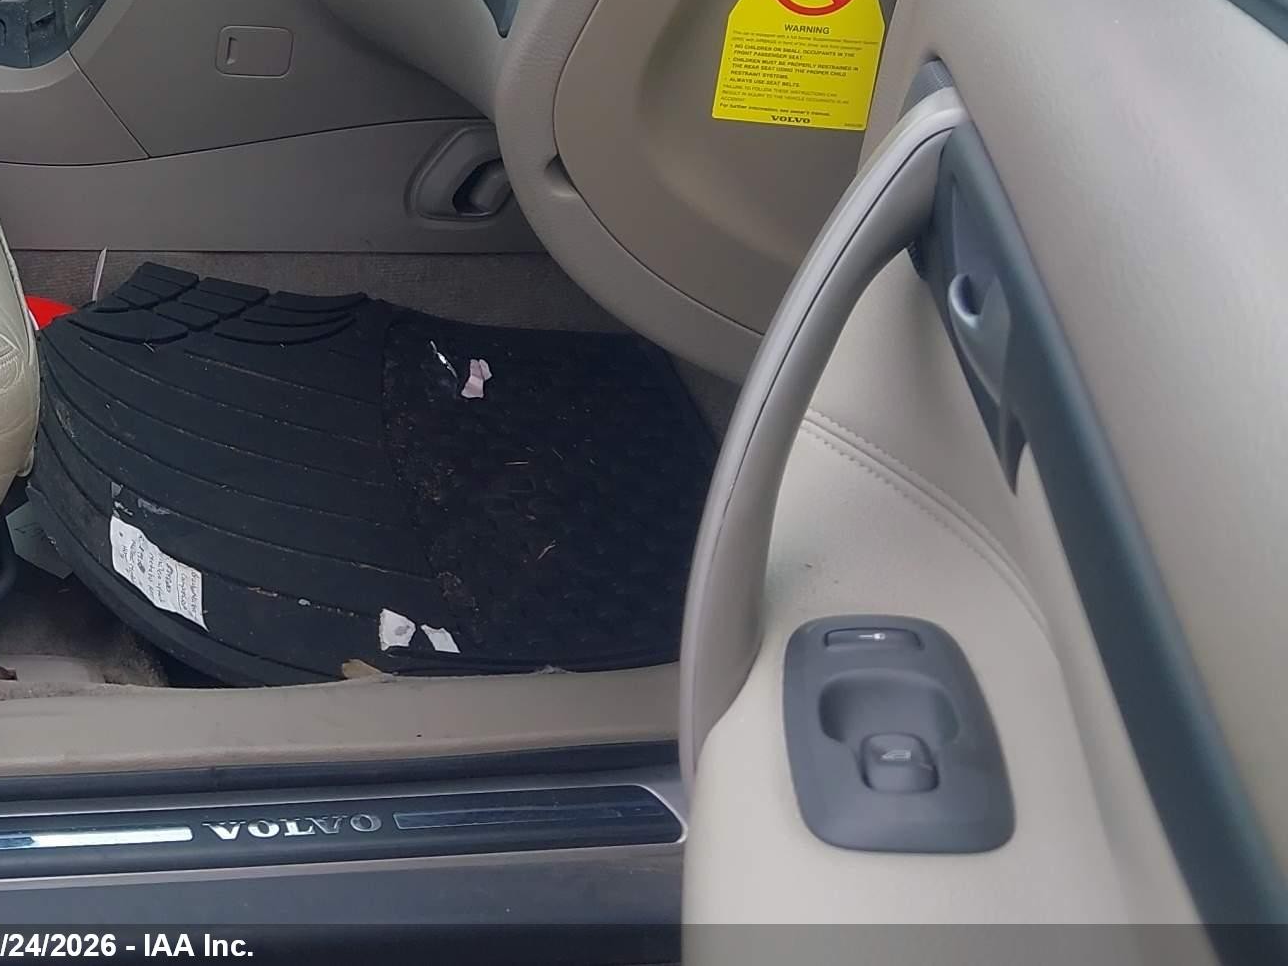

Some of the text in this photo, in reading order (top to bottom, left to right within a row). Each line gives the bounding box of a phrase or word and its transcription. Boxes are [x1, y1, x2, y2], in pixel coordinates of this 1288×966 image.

[784, 24, 830, 35] WARNING
[771, 115, 811, 123] VOLVO
[202, 814, 382, 840] VOLVO
